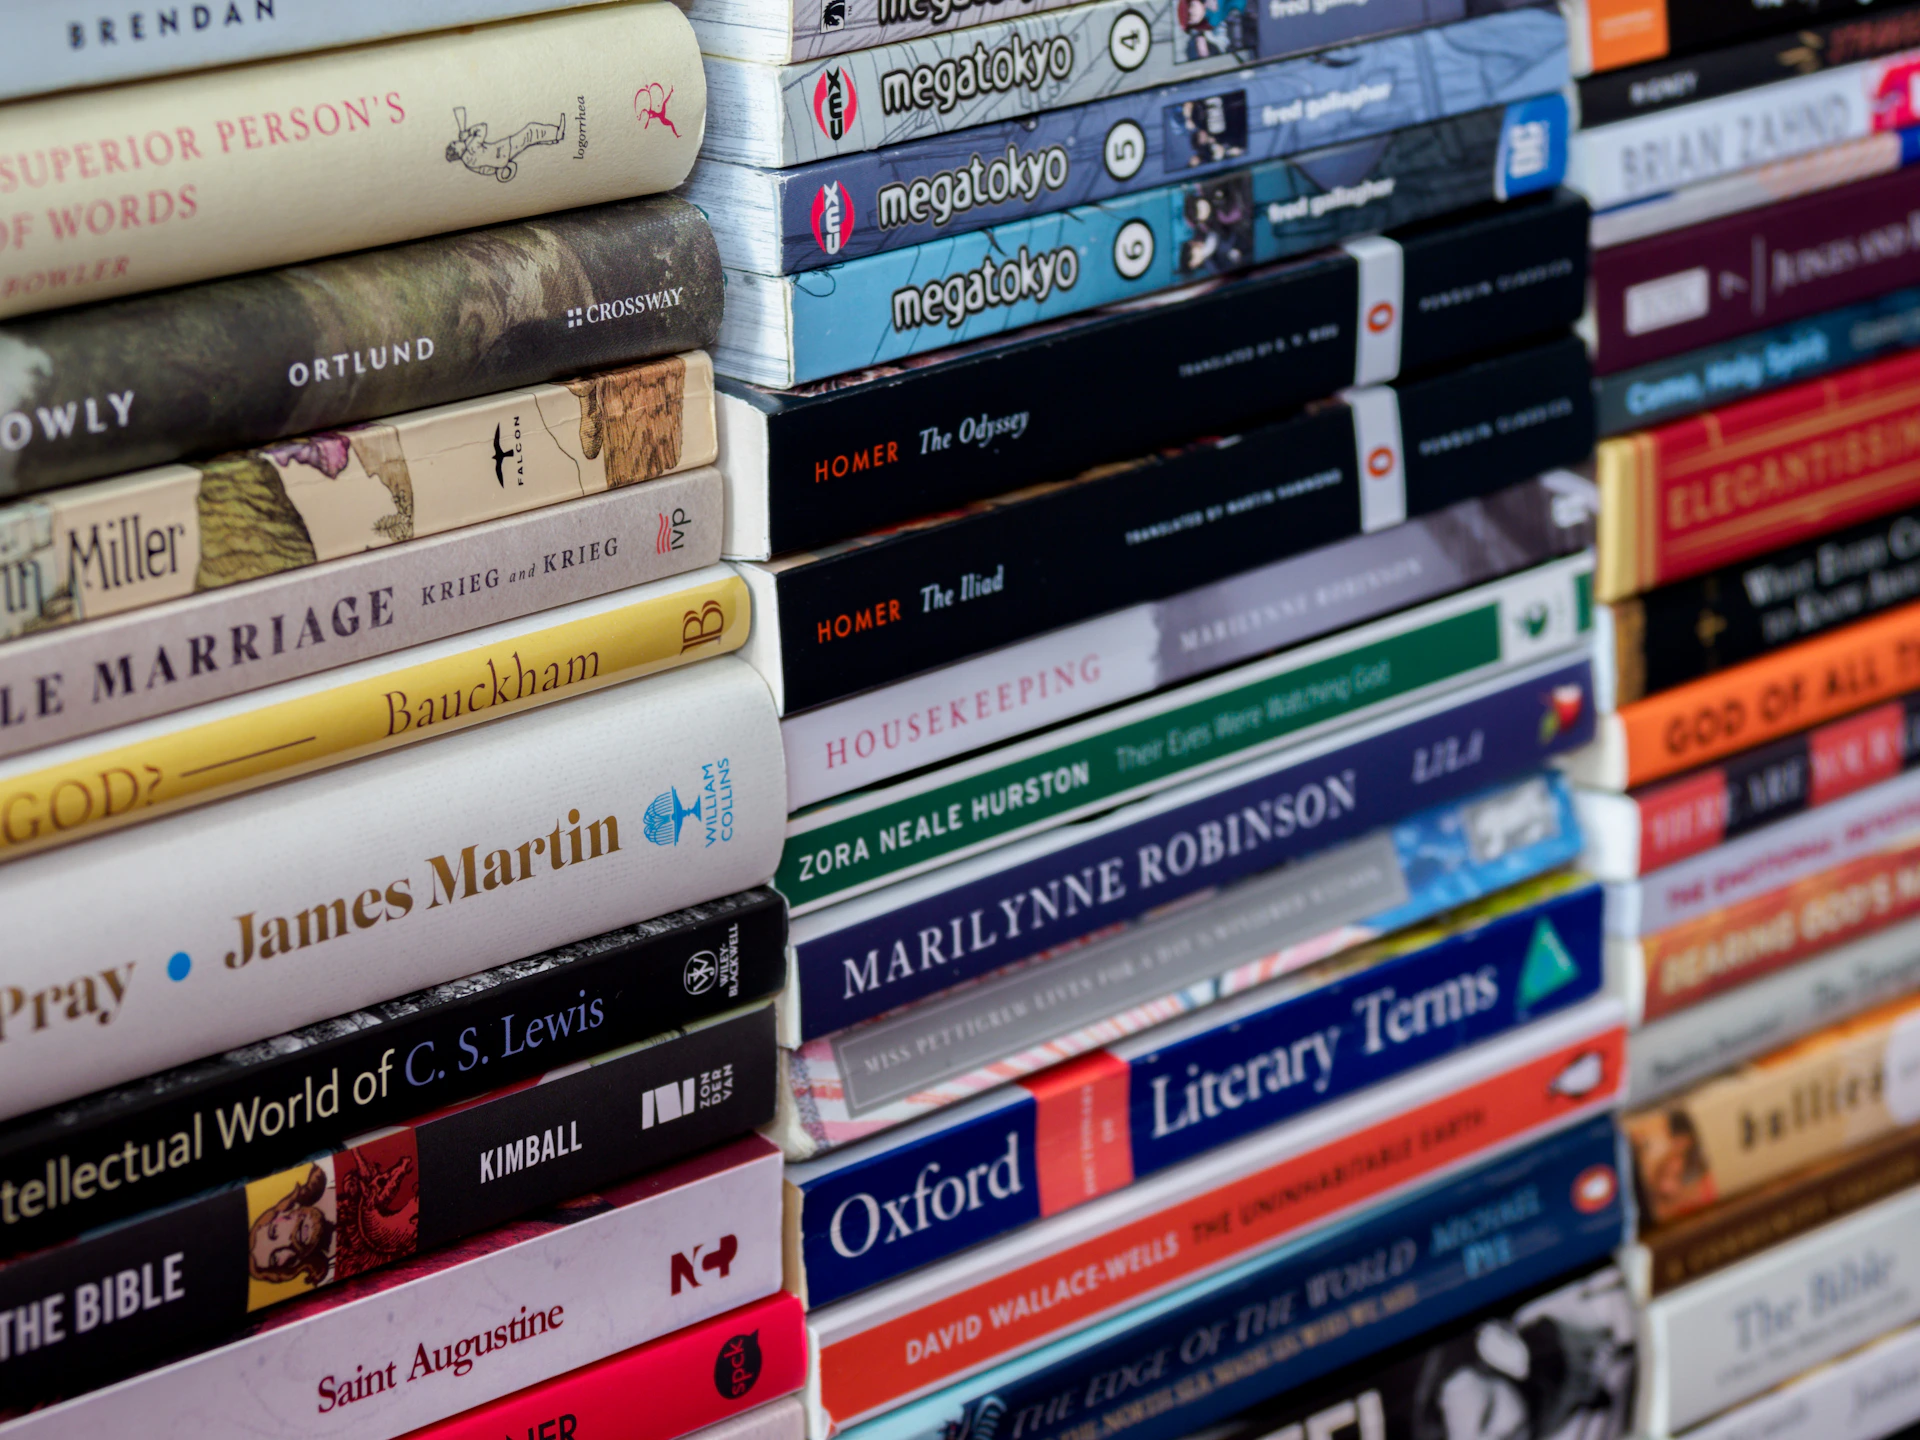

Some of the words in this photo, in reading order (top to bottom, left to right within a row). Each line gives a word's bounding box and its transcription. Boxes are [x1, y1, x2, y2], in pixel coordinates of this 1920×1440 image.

[66, 0, 277, 51] BRENDAN
[880, 34, 1076, 117] megatokyo
[0, 126, 203, 194] SUPERIOR
[215, 91, 406, 154] PERSON'S
[572, 94, 586, 160] logorrhea
[1620, 123, 1724, 195] BRIAN
[1738, 91, 1852, 163] ZAHND
[47, 184, 199, 241] WORDS
[877, 144, 1069, 231] megatokyo
[585, 286, 684, 325] CROSSWAY
[891, 244, 1080, 333] megatokyo
[287, 337, 436, 388] ORTLUND
[0, 390, 135, 451] OWLY
[516, 415, 525, 487] FALCON
[814, 441, 900, 482] HOMER
[918, 426, 952, 455] The
[958, 410, 1030, 448] Odyssey
[67, 512, 186, 599] Miller
[421, 568, 501, 607] KRIEG
[508, 562, 536, 584] and
[542, 536, 619, 575] KRIEG
[816, 598, 902, 644] HOMER
[919, 583, 955, 613] The
[960, 564, 1005, 602] Iliad
[0, 672, 64, 728] LE
[92, 585, 395, 705] MARRIAGE
[2, 763, 164, 847] GOD?
[382, 650, 600, 738] Bauckham
[825, 653, 1103, 769] HOUSEKEEPING
[1662, 695, 1748, 758] GOD
[1757, 676, 1808, 724] OF
[1822, 653, 1883, 698] ALL
[720, 756, 733, 843] COLLINS
[798, 836, 870, 883] ZORA
[879, 803, 964, 855] NEALE
[971, 760, 1091, 823] HURSTON
[1115, 737, 1163, 772] Their
[1165, 722, 1212, 758] Eyes
[1212, 703, 1264, 740] Were
[1266, 674, 1352, 723] Watching
[1411, 729, 1486, 785] LILA
[704, 762, 718, 849] WILLIAM
[224, 877, 414, 970] James
[424, 808, 624, 909] Martin
[842, 856, 1127, 1000] MARILYNNE
[1137, 769, 1358, 890] ROBINSON
[728, 922, 739, 998] BLACKWELL
[699, 1071, 712, 1110] ZON
[711, 1068, 723, 1106] DER
[722, 1062, 734, 1101] VAN
[1149, 1023, 1343, 1140] Literary
[1352, 963, 1500, 1057] Terms
[0, 1111, 203, 1225] tellectual
[215, 1067, 339, 1151] World
[352, 1047, 396, 1107] of
[404, 1039, 446, 1087] C.
[457, 1025, 489, 1072] S.
[500, 989, 605, 1058] Lewis
[479, 1119, 584, 1185] KIMBALL
[829, 1130, 1024, 1259] Oxford
[1192, 1210, 1232, 1244] THE
[0, 1291, 66, 1363] THE
[74, 1251, 186, 1335] BIBLE
[905, 1314, 982, 1366] DAVID
[988, 1231, 1180, 1330] WALLACE-WELLS
[1178, 1320, 1229, 1364] OF
[1306, 1236, 1418, 1309] WORLD
[317, 1360, 398, 1414] Saint
[406, 1303, 565, 1384] Augustine
[723, 1337, 752, 1396] spck
